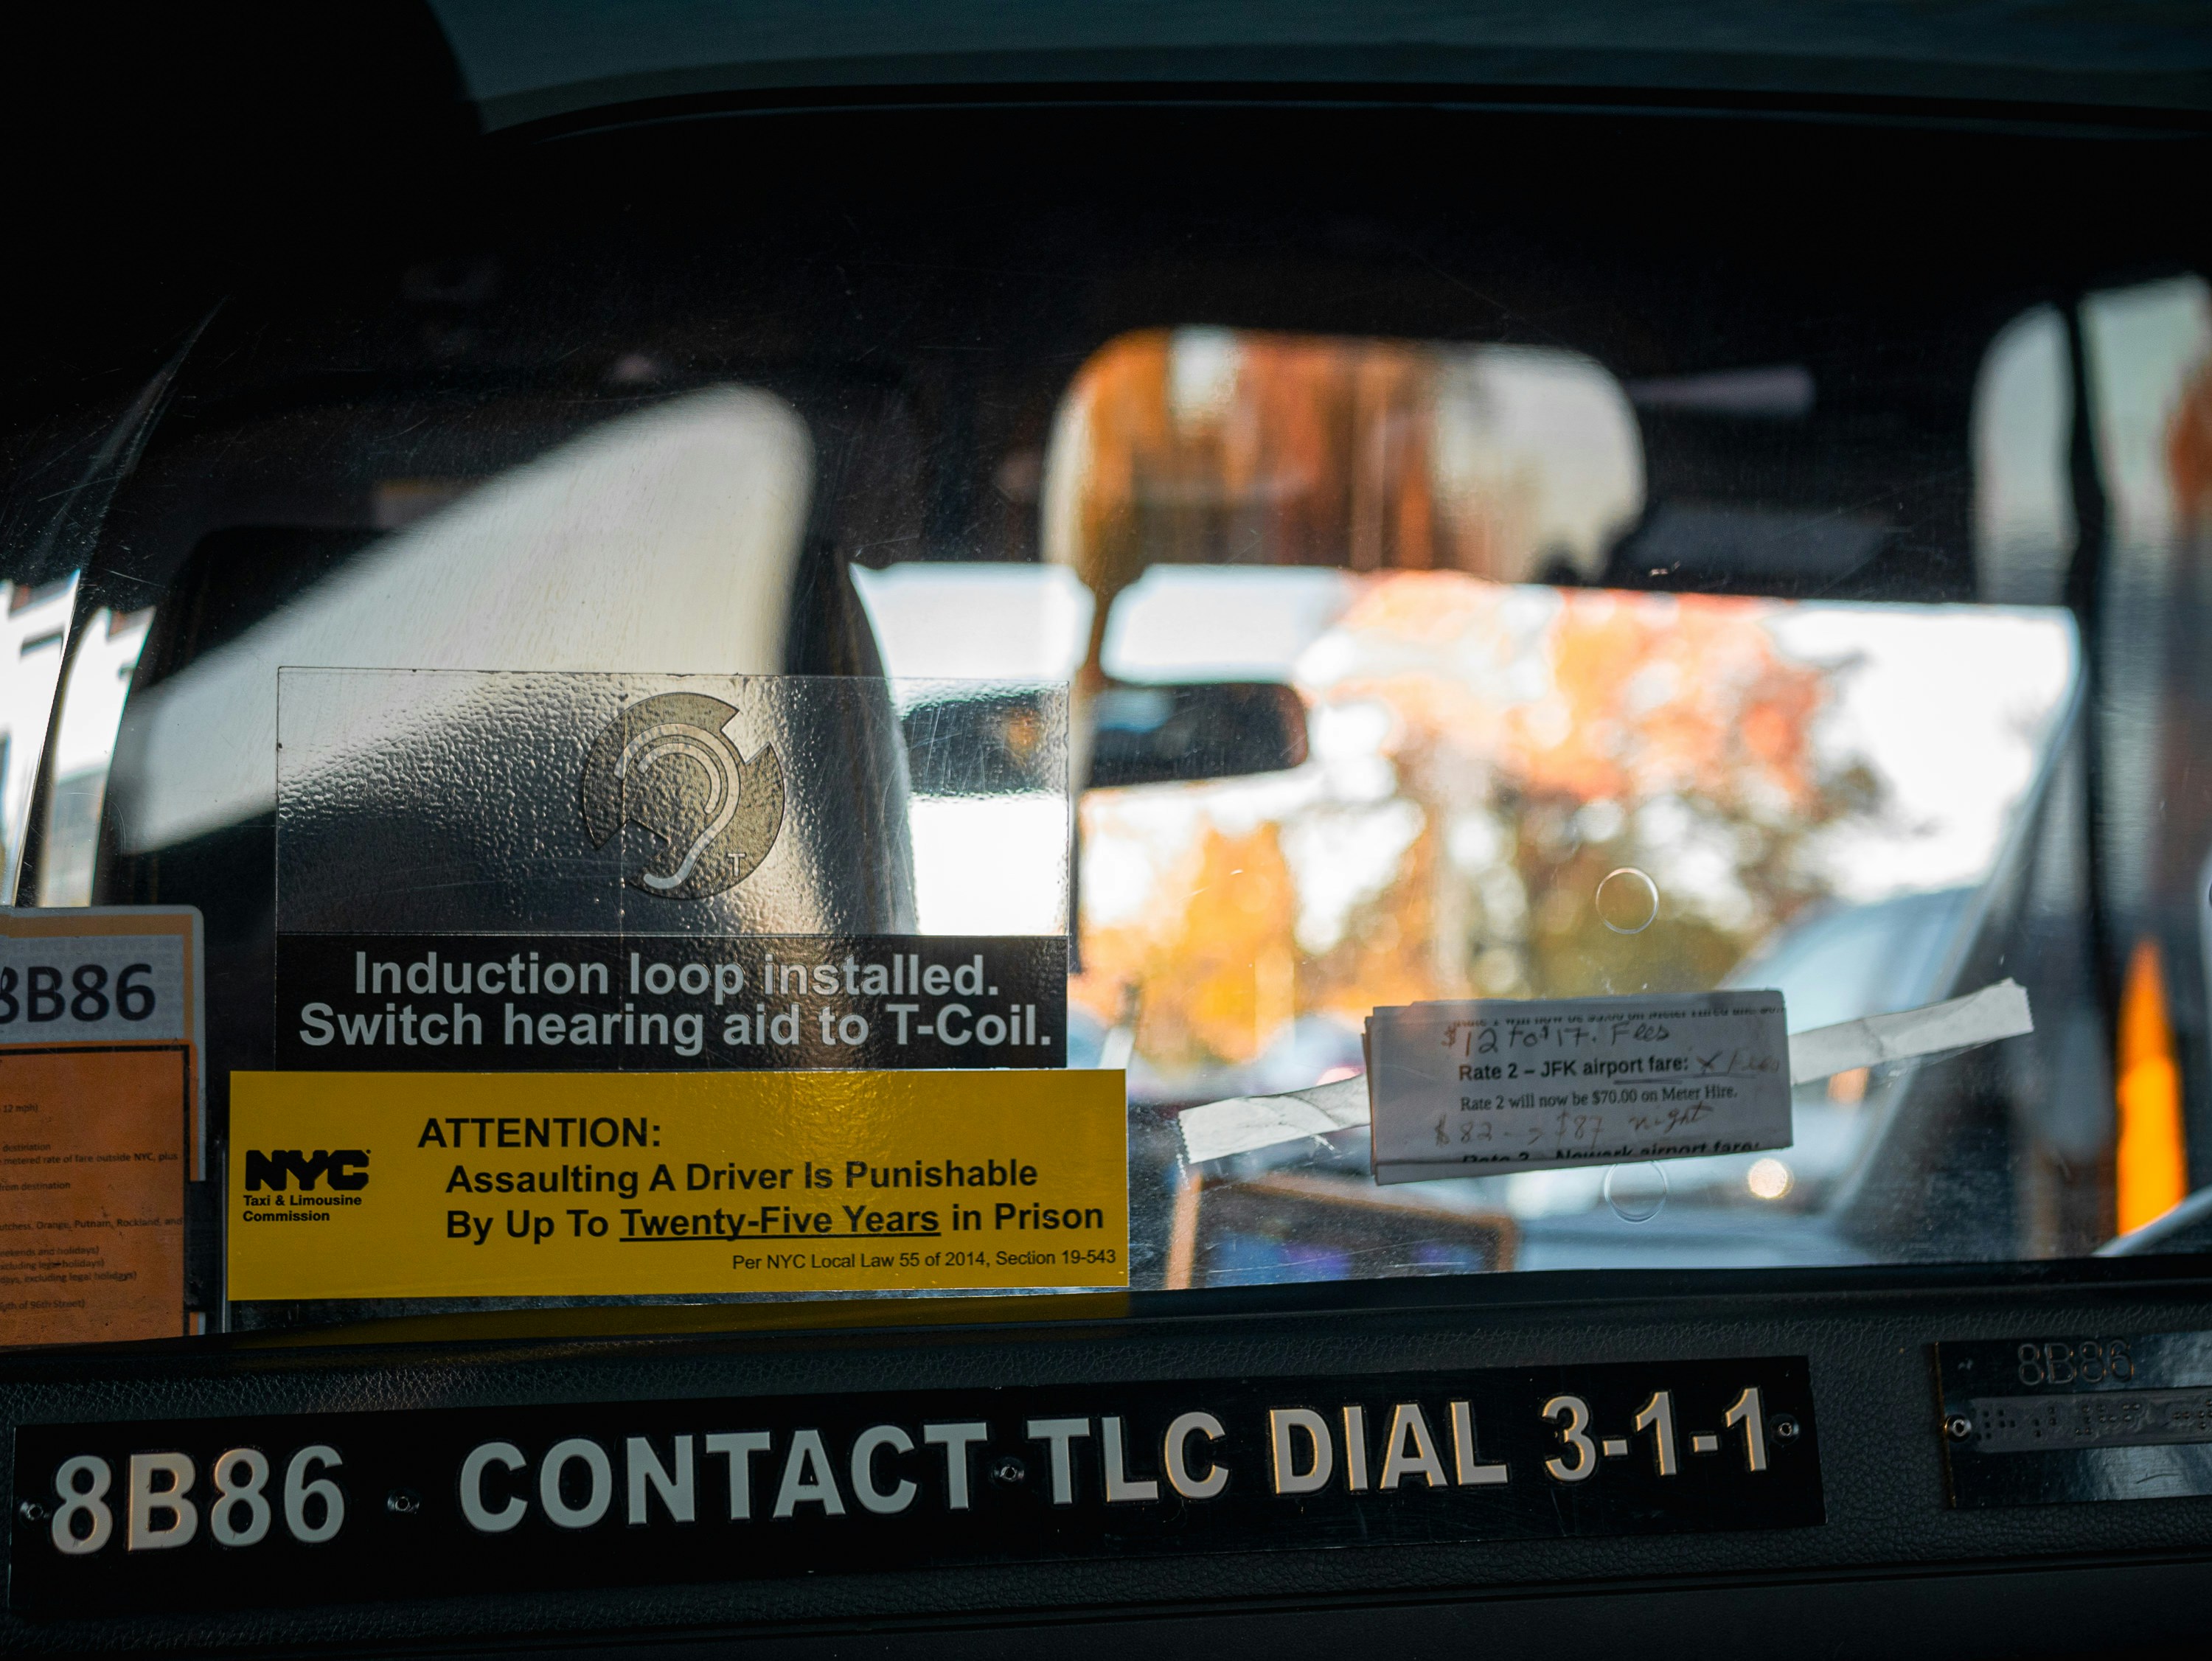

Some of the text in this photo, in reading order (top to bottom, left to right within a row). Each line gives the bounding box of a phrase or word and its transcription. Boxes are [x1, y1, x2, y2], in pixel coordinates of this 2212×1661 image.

[728, 853, 745, 877] T
[355, 951, 999, 1006] Induction loop installed.
[299, 1002, 1051, 1056] Switch hearing aid to T-Coil.
[1459, 1064, 1501, 1082] Rate
[1507, 1062, 1519, 1079] 2
[1540, 1059, 1577, 1078] JFK
[1583, 1056, 1644, 1079] airport
[1647, 1055, 1688, 1074] fare:
[1461, 1084, 1738, 1111] Rate 2 will now be $70.00 on Meter Hire.
[418, 1117, 661, 1149] ATTENTION:
[2, 1143, 51, 1153] destination
[43, 1155, 61, 1164] rate
[62, 1155, 73, 1163] of
[245, 1149, 369, 1191] NYC
[445, 1159, 1038, 1199] Assaulting A Driver Is Punishable
[21, 1180, 71, 1191] destination
[243, 1194, 362, 1206] Taxi & Limousine
[243, 1210, 330, 1222] Commission
[446, 1202, 1104, 1246] By Up To Twenty-Five Years in Prison
[732, 1249, 1116, 1270] Per NYC Local Law 55 of 2014, Section 19-543
[2018, 1339, 2135, 1386] 8B86
[51, 1387, 1767, 1555] 8B86 CONTACT TLC DIAL 3-1-1
